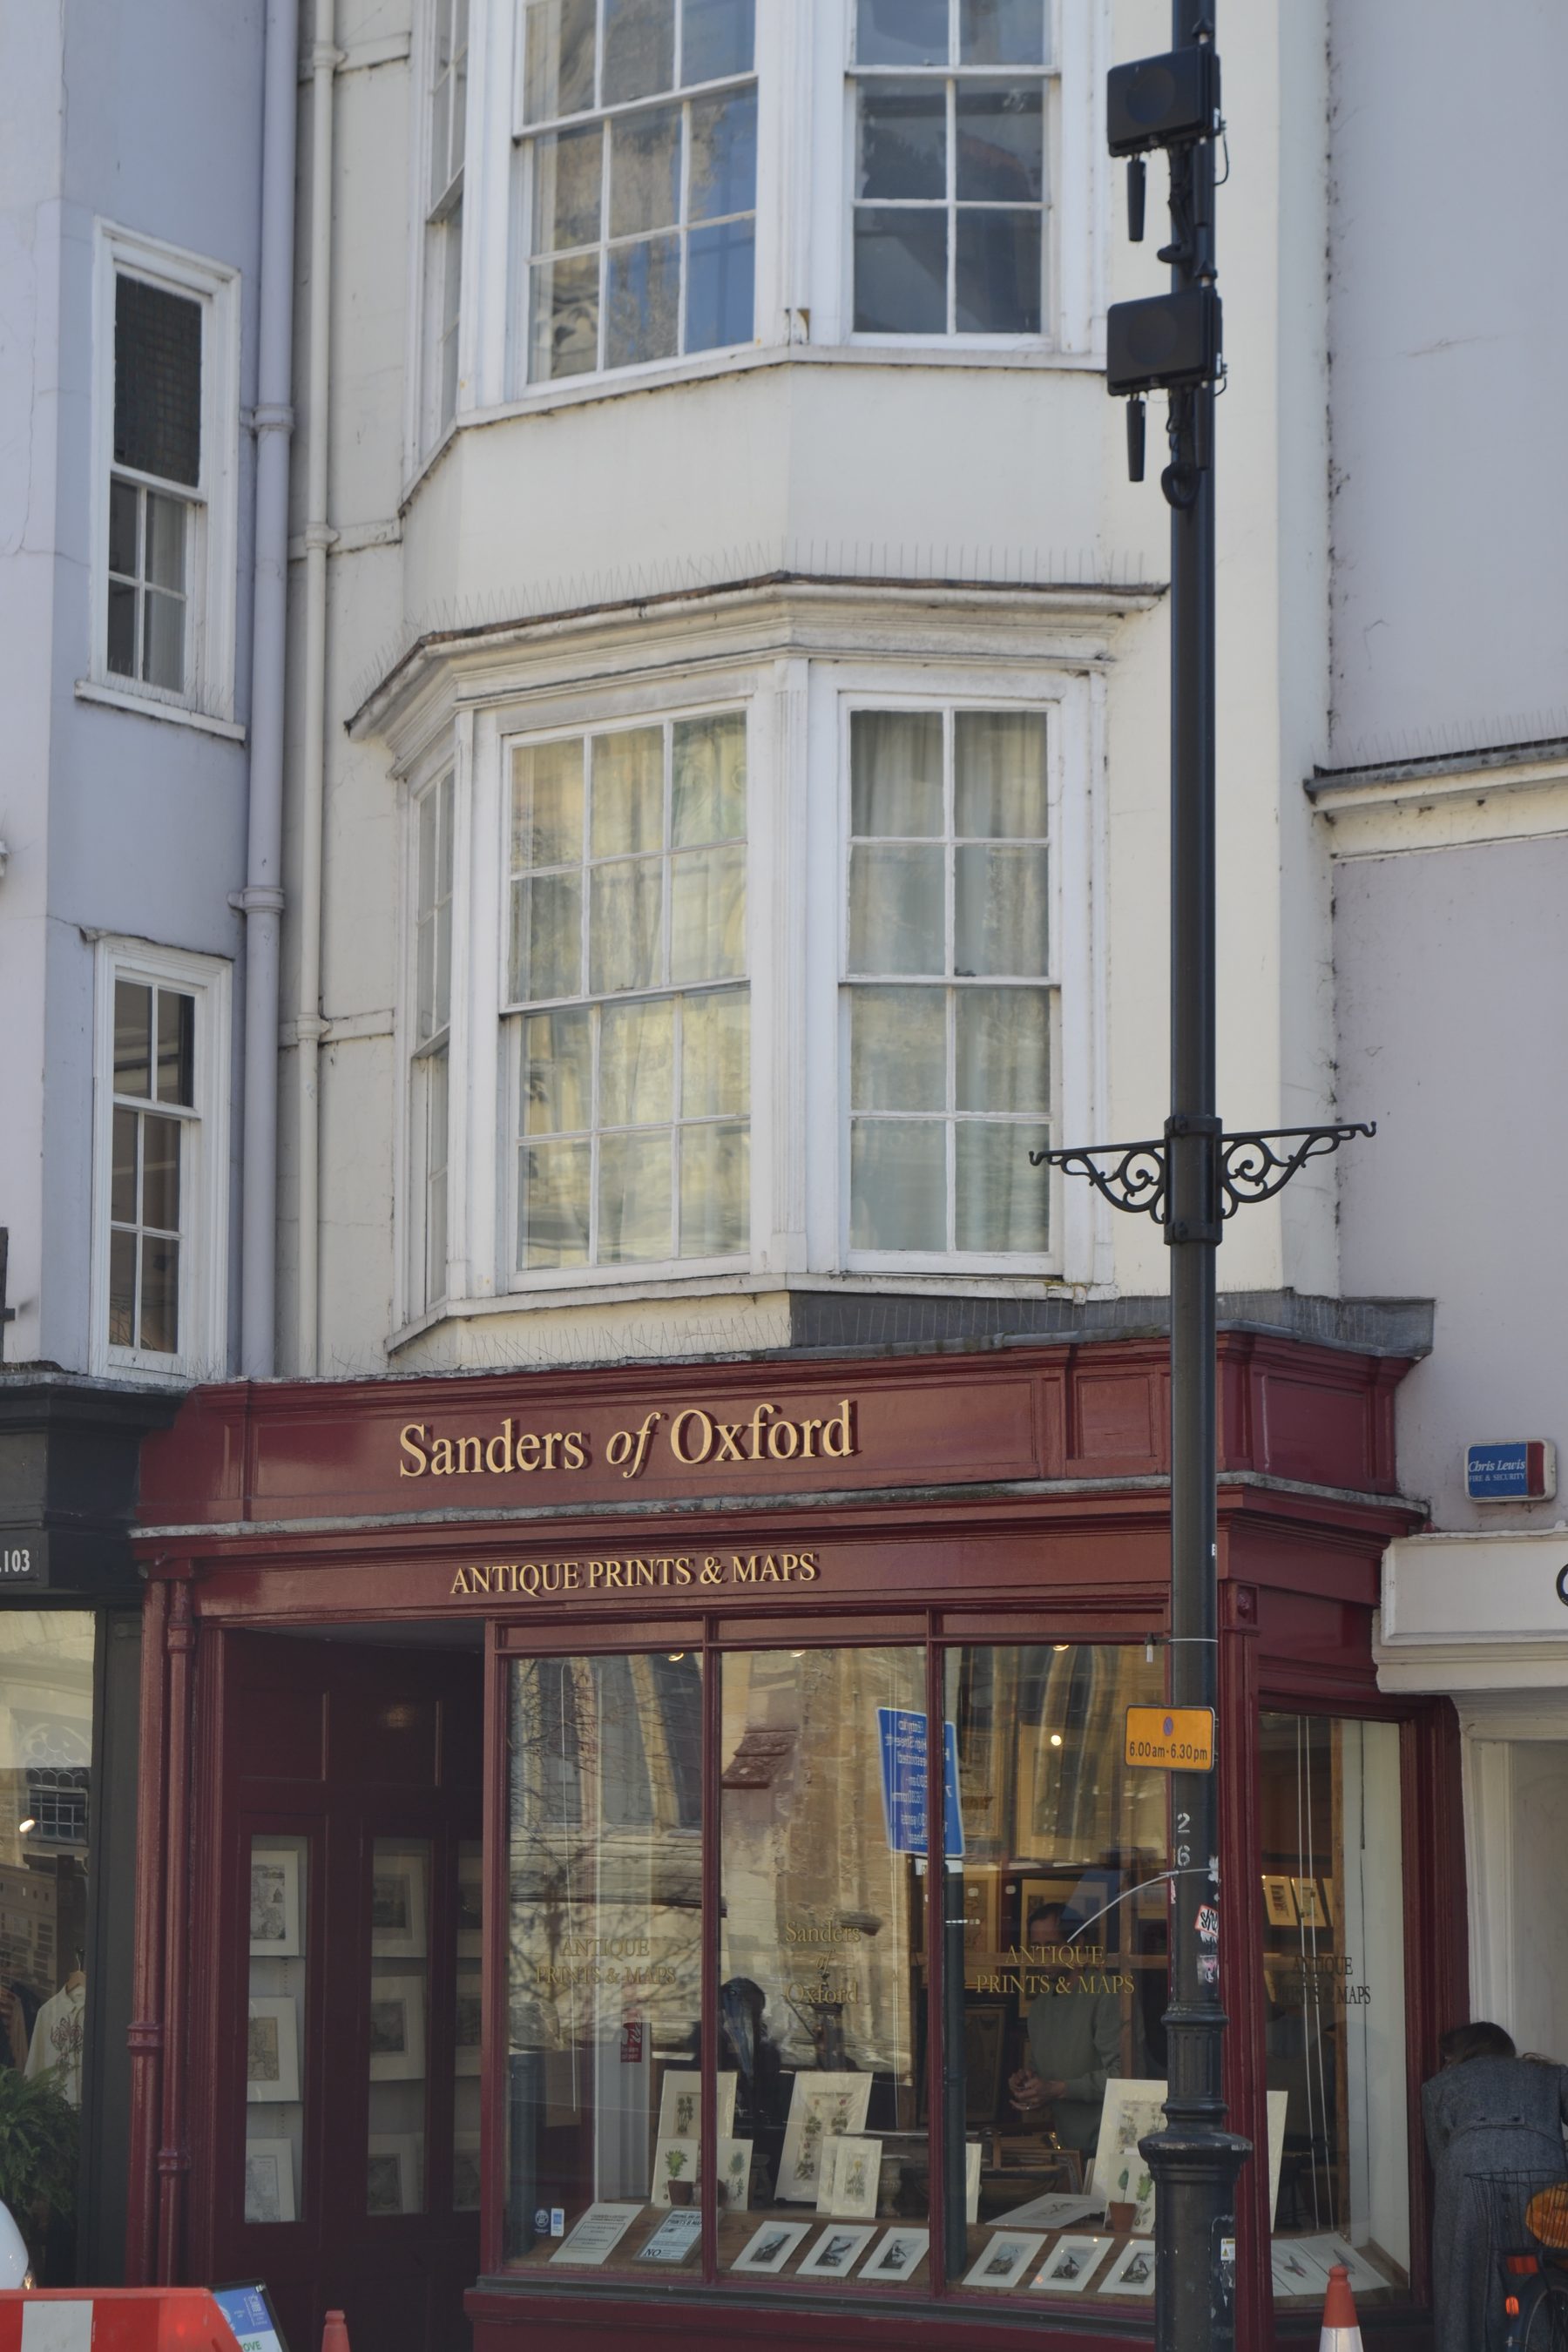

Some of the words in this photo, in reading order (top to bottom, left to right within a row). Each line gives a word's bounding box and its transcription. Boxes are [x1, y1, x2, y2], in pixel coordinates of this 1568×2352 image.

[400, 1418, 585, 1477] Sanders
[606, 1412, 661, 1478] of
[670, 1400, 855, 1464] Oxford
[1469, 1461, 1495, 1472] Chris
[1497, 1459, 1525, 1470] Lewis
[4, 1550, 30, 1571] 103
[450, 1562, 579, 1598] ANTIQUE
[589, 1557, 692, 1589] PRINTS
[700, 1556, 724, 1584] &
[731, 1552, 816, 1583] MAPS
[786, 1920, 862, 1943] Sanders
[559, 1938, 651, 1961] ANTIQUE
[1005, 1945, 1105, 1970] ANTIQUE
[815, 1949, 836, 1976] of
[536, 1965, 600, 1984] PRINTS
[605, 1967, 620, 1984] &
[624, 1966, 677, 1984] MAPS
[976, 1975, 1051, 1994] PRINTS
[1055, 1976, 1071, 1994] &
[1078, 1975, 1135, 1994] MAPS
[786, 1977, 859, 2004] Oxford
[1337, 1985, 1371, 2004] MAPS
[644, 2248, 662, 2258] NO
[242, 2340, 262, 2352] OVE
